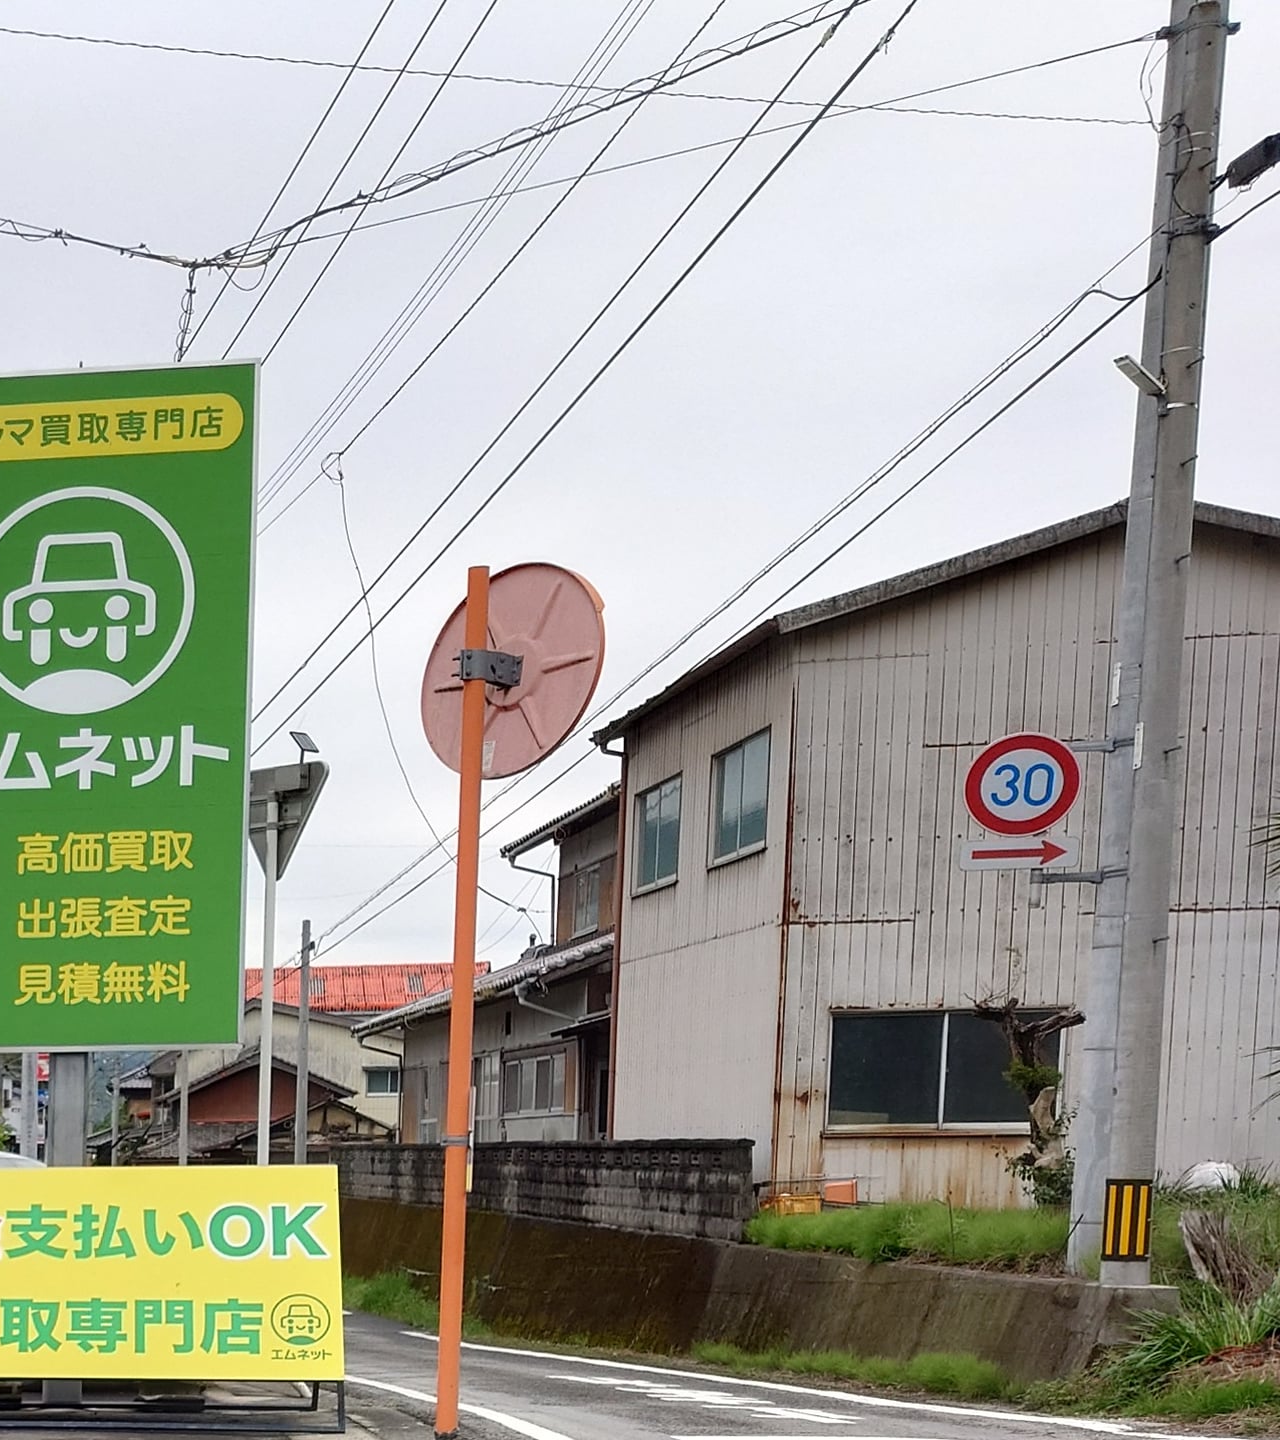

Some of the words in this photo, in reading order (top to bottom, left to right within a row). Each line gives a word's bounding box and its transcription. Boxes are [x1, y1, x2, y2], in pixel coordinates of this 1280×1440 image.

[990, 763, 1055, 807] 30
[16, 831, 194, 875] 高価買取
[16, 897, 191, 940] 出張査定
[14, 961, 190, 1006] 見積無料
[271, 1349, 333, 1360] エムネット
